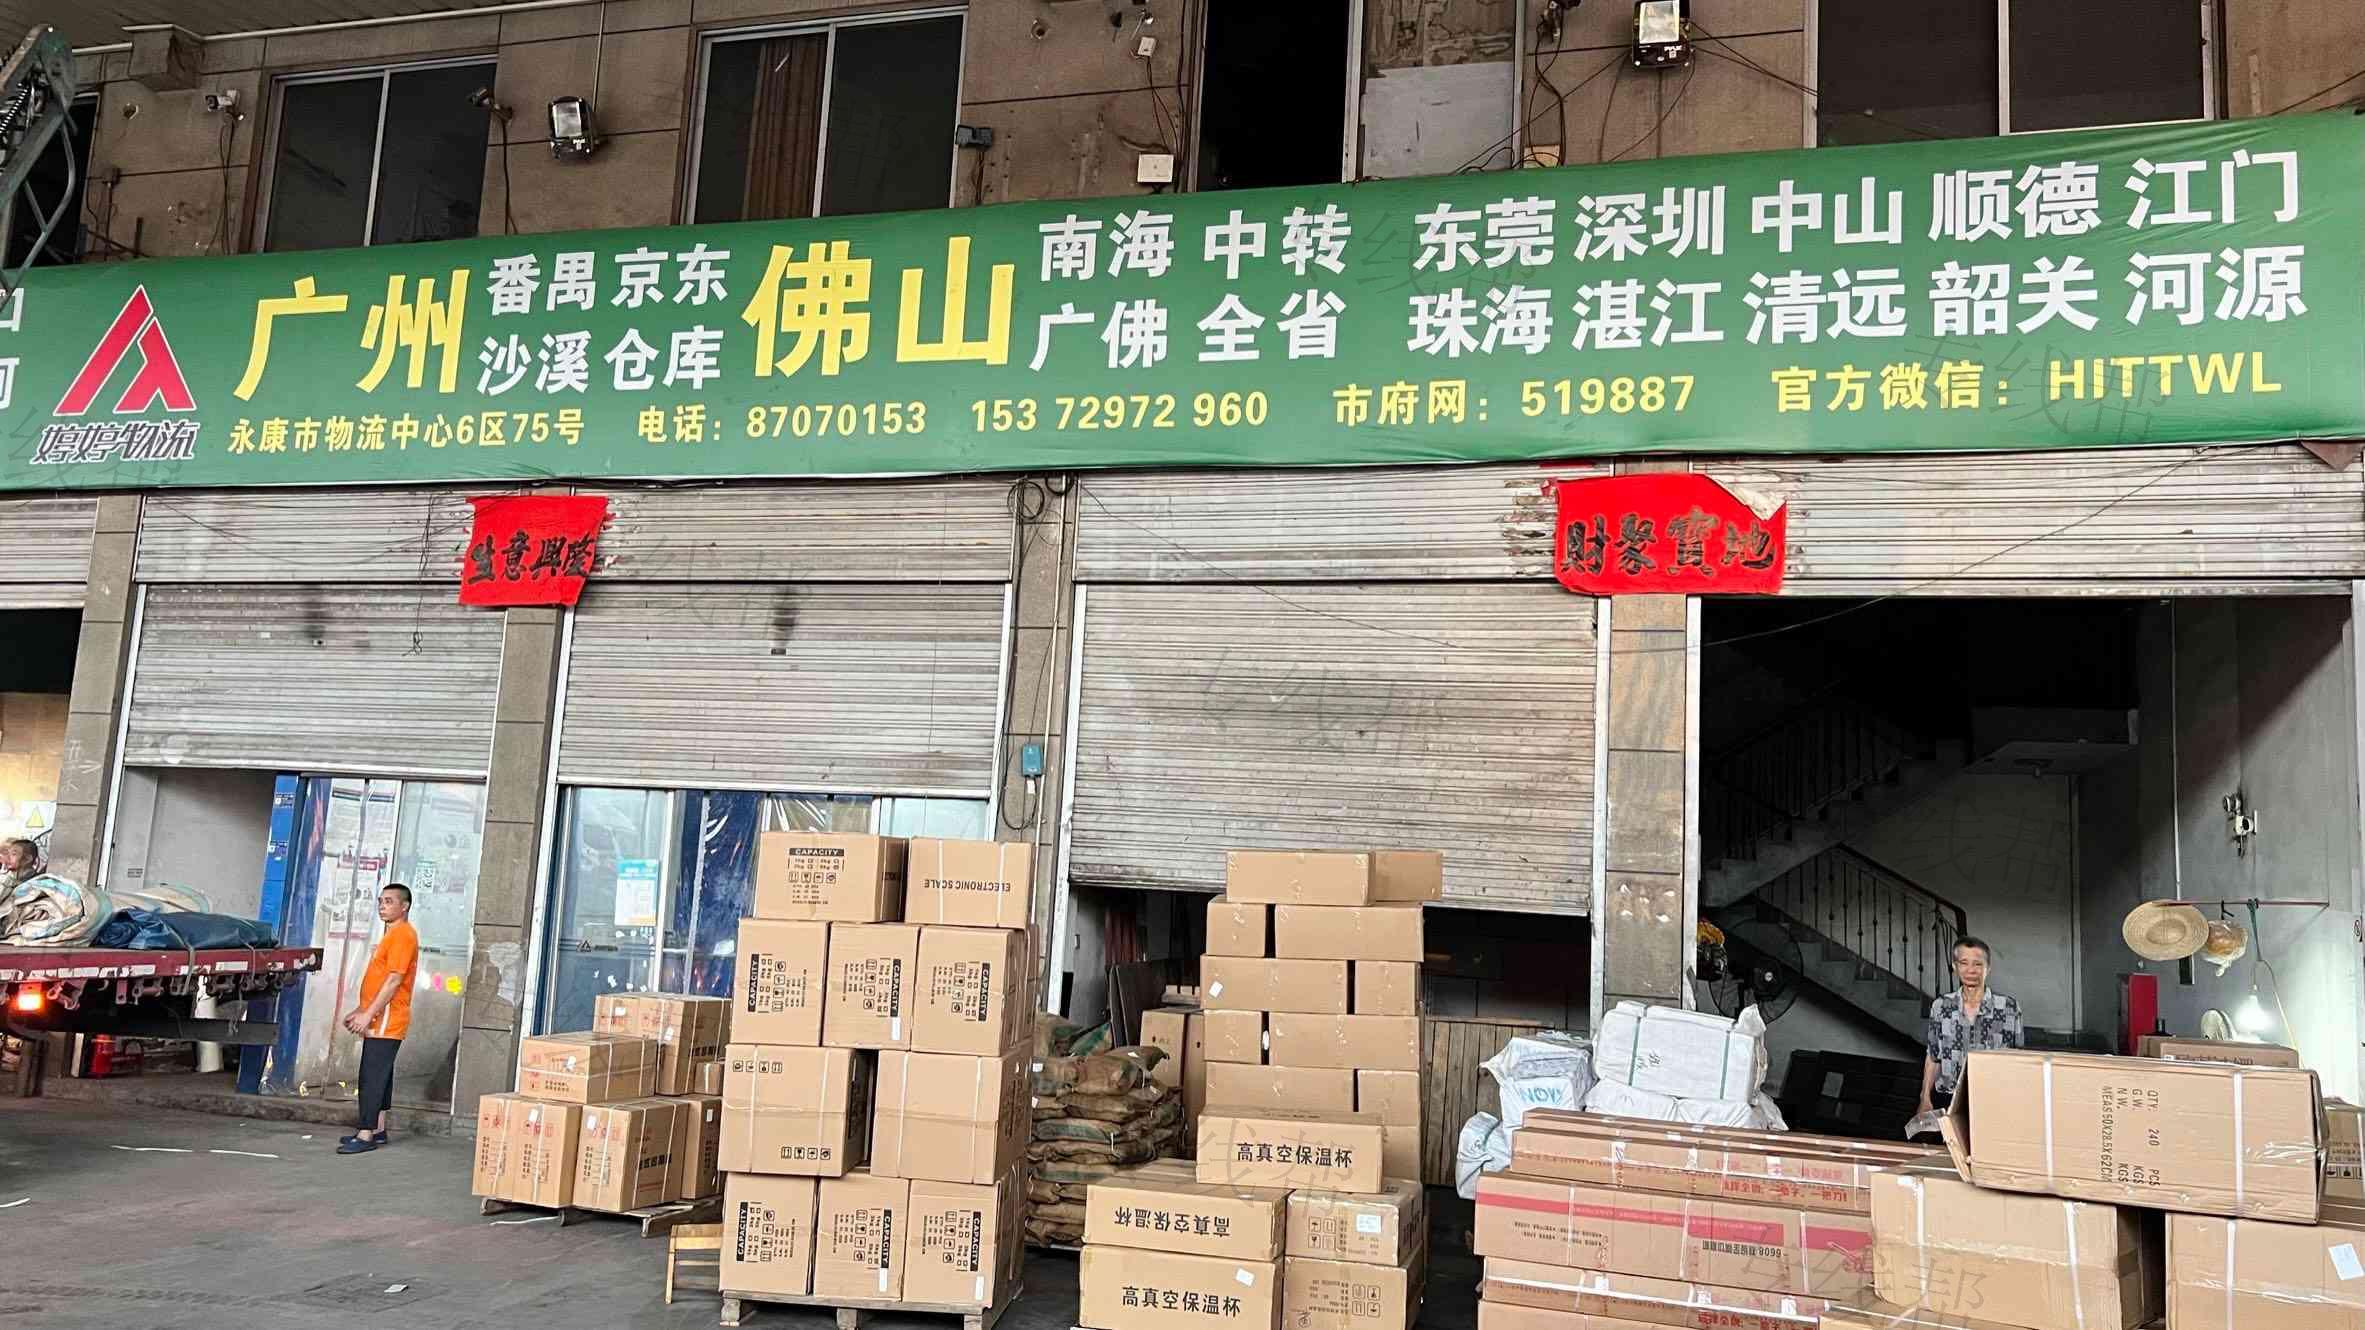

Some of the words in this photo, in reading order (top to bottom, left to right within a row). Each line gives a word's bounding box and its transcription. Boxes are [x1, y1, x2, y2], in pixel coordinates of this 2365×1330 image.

[1412, 196, 1556, 273] 东莞
[1573, 185, 1726, 262] 深圳
[1751, 176, 1903, 253] 中山
[1927, 161, 2102, 242] 顺德
[2124, 148, 2299, 230] 江门
[1039, 210, 1175, 282] 南海
[1203, 204, 1352, 280] 中转
[486, 251, 596, 316] 番禺
[610, 243, 731, 308] 京东
[1406, 284, 1554, 358] 珠海
[1571, 278, 1724, 351] 湛江
[1742, 268, 1908, 345] 清远
[1928, 255, 2100, 337] 韶关
[2124, 244, 2308, 326] 河源
[741, 236, 1015, 378] 佛山
[1028, 298, 1168, 372] 广佛
[1196, 288, 1347, 362] 全省
[233, 269, 470, 402] 广州
[476, 330, 592, 396] 沙溪
[604, 324, 724, 391] 仓库
[2049, 351, 2282, 401] HITTWL
[746, 401, 927, 438] 87070153
[971, 398, 1037, 433] 153
[1055, 393, 1176, 430] 72972
[1193, 391, 1268, 427] 960
[1521, 375, 1695, 417] 519887
[29, 418, 201, 465] 婷婷物流
[227, 411, 585, 455] 永康市物流中心6区75号
[794, 847, 840, 857] CAPACITY
[923, 878, 954, 890] SCALE
[952, 880, 1012, 893] ELECTRONIC
[747, 960, 759, 1010] CAPACITY
[891, 963, 902, 1012] CAPACITY
[978, 968, 990, 1016] CAPACITY
[1236, 1141, 1353, 1170] 高真空保温杯
[2147, 1128, 2161, 1146] 240
[2118, 1162, 2130, 1183] KGS
[2132, 1165, 2145, 1185] KGS
[736, 1207, 749, 1258] CAPACITY
[880, 1214, 893, 1265] CAPACITY
[969, 1217, 982, 1267] CAPACITY
[1113, 1205, 1231, 1238] 高真空保温杯
[1121, 1285, 1241, 1317] 高真空保温杯
